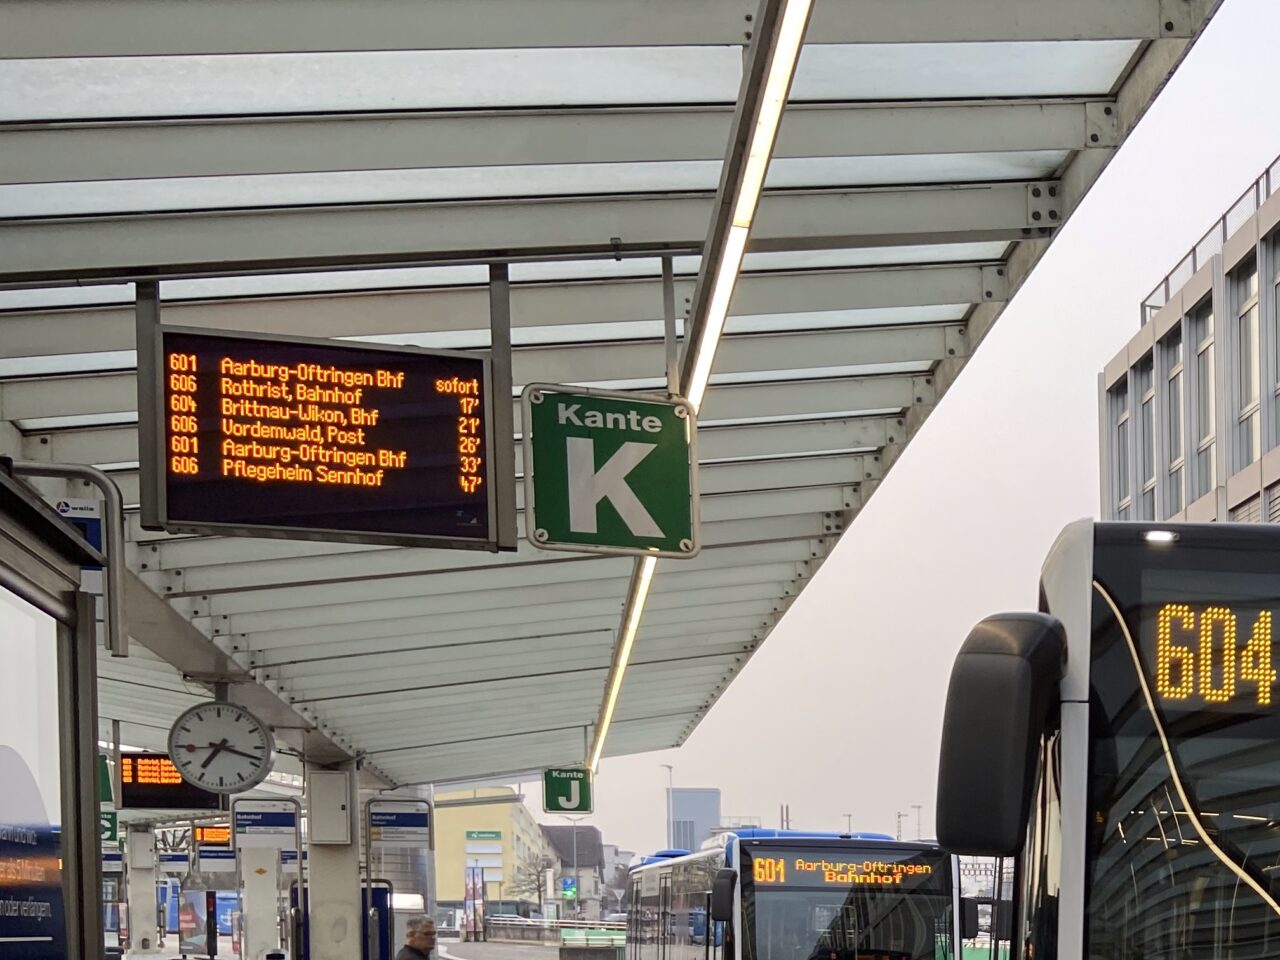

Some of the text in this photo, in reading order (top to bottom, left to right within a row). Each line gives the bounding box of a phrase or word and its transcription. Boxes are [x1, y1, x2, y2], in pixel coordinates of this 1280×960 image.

[170, 353, 479, 395] 601 Aarburg-Oftringen Bhf sofort
[170, 373, 197, 392] 606
[221, 377, 293, 402] Rothrist,
[297, 384, 362, 405] Bahnhof
[171, 394, 197, 412] 604
[222, 398, 347, 427] Brittnau-Wikon,
[351, 408, 379, 426] Bhf
[558, 403, 662, 433] Kante
[171, 415, 198, 433] 606
[222, 418, 324, 444] Vordemwald,
[328, 426, 365, 445] Post
[171, 435, 199, 454] 601
[223, 438, 375, 467] Aarburg-Oftringen
[379, 450, 407, 468] Bhf
[172, 456, 199, 474] 606
[223, 459, 312, 481] Pflegeheim
[316, 466, 383, 486] Sennhof
[566, 436, 666, 538] K
[1156, 603, 1277, 705] 604
[552, 770, 584, 779] Kante
[558, 780, 580, 809] J
[753, 857, 931, 883] 601 Aarburg-Oftringen
[825, 871, 903, 884] Bahnhof
